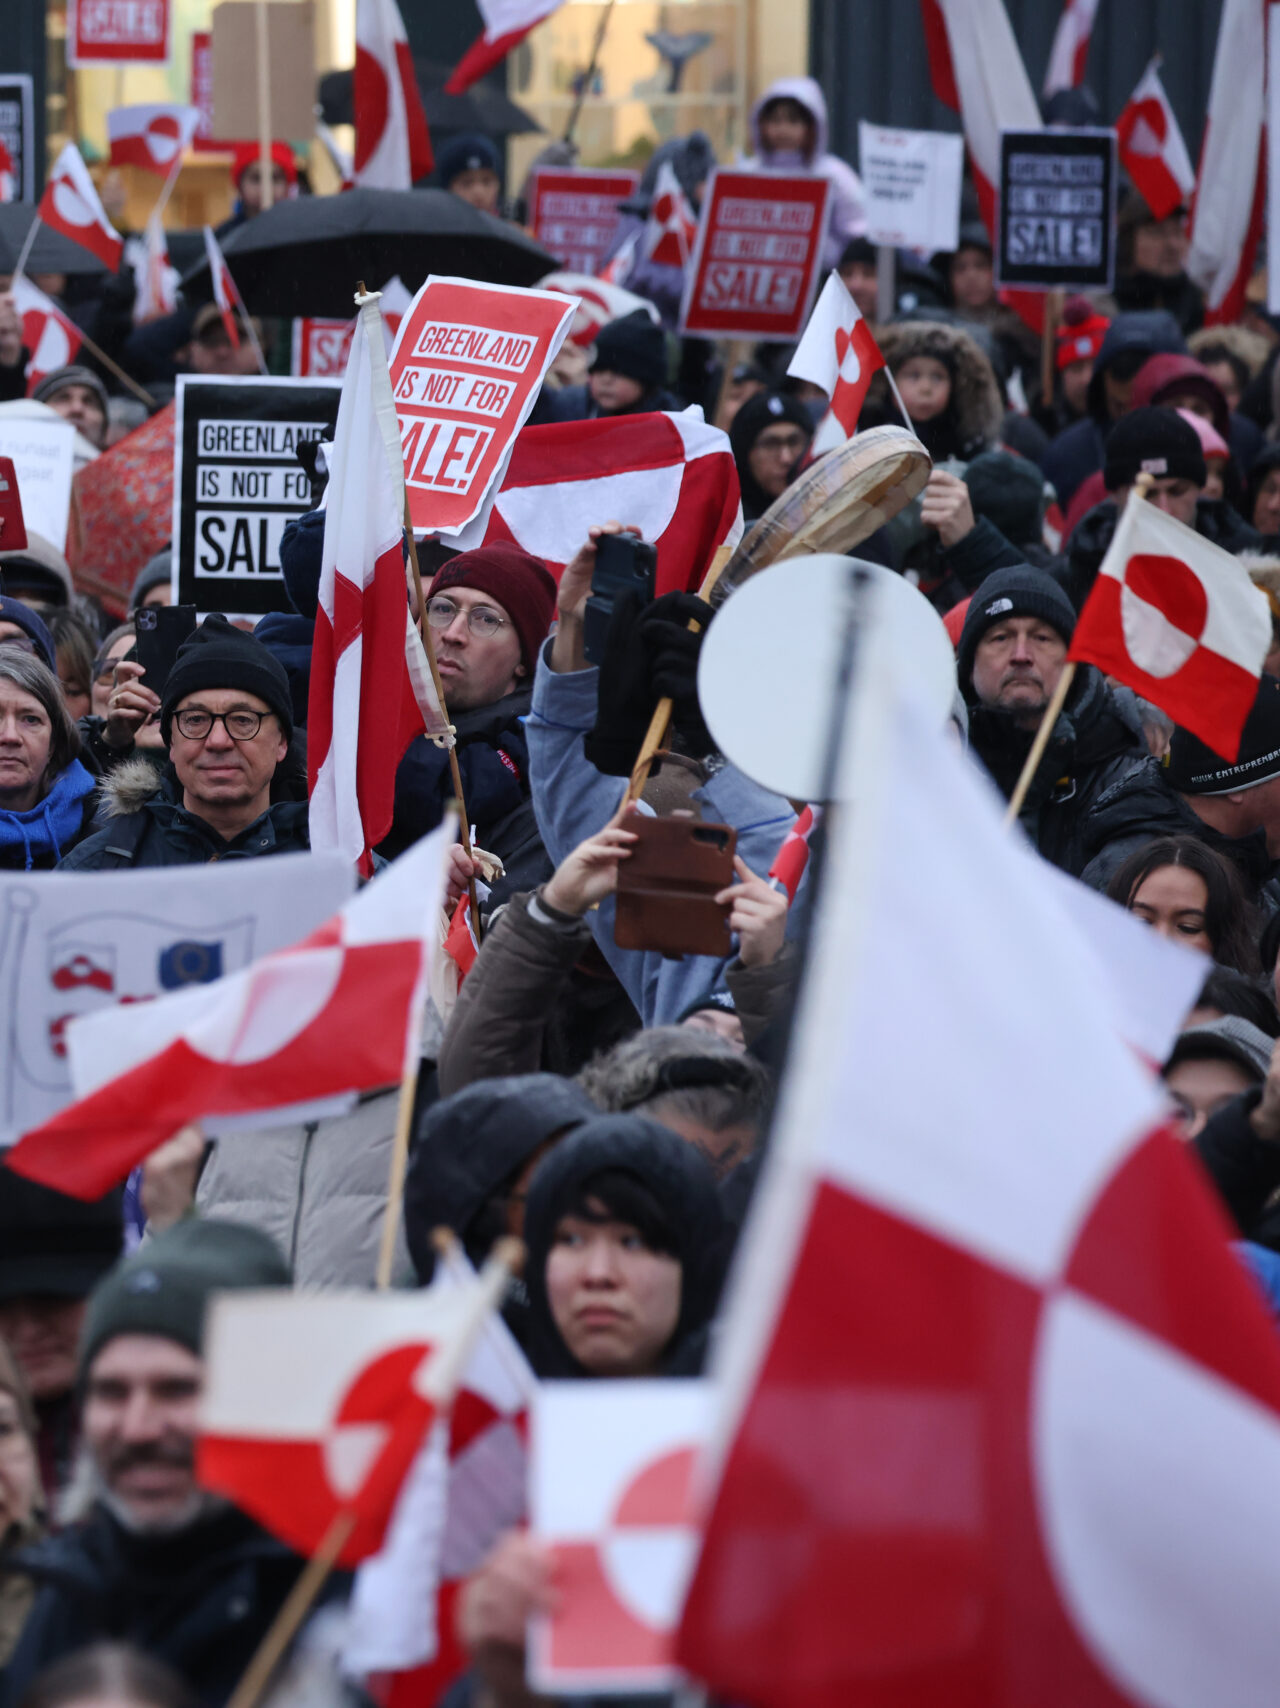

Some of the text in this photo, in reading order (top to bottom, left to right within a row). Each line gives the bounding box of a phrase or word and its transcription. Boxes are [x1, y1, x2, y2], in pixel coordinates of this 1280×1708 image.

[1013, 222, 1097, 257] SALE!
[708, 267, 798, 306] SALE!
[418, 326, 532, 368] GREENLAND
[395, 371, 510, 412] IS NOT FOR
[201, 471, 311, 499] IS NOT FO
[200, 516, 298, 573] SAL
